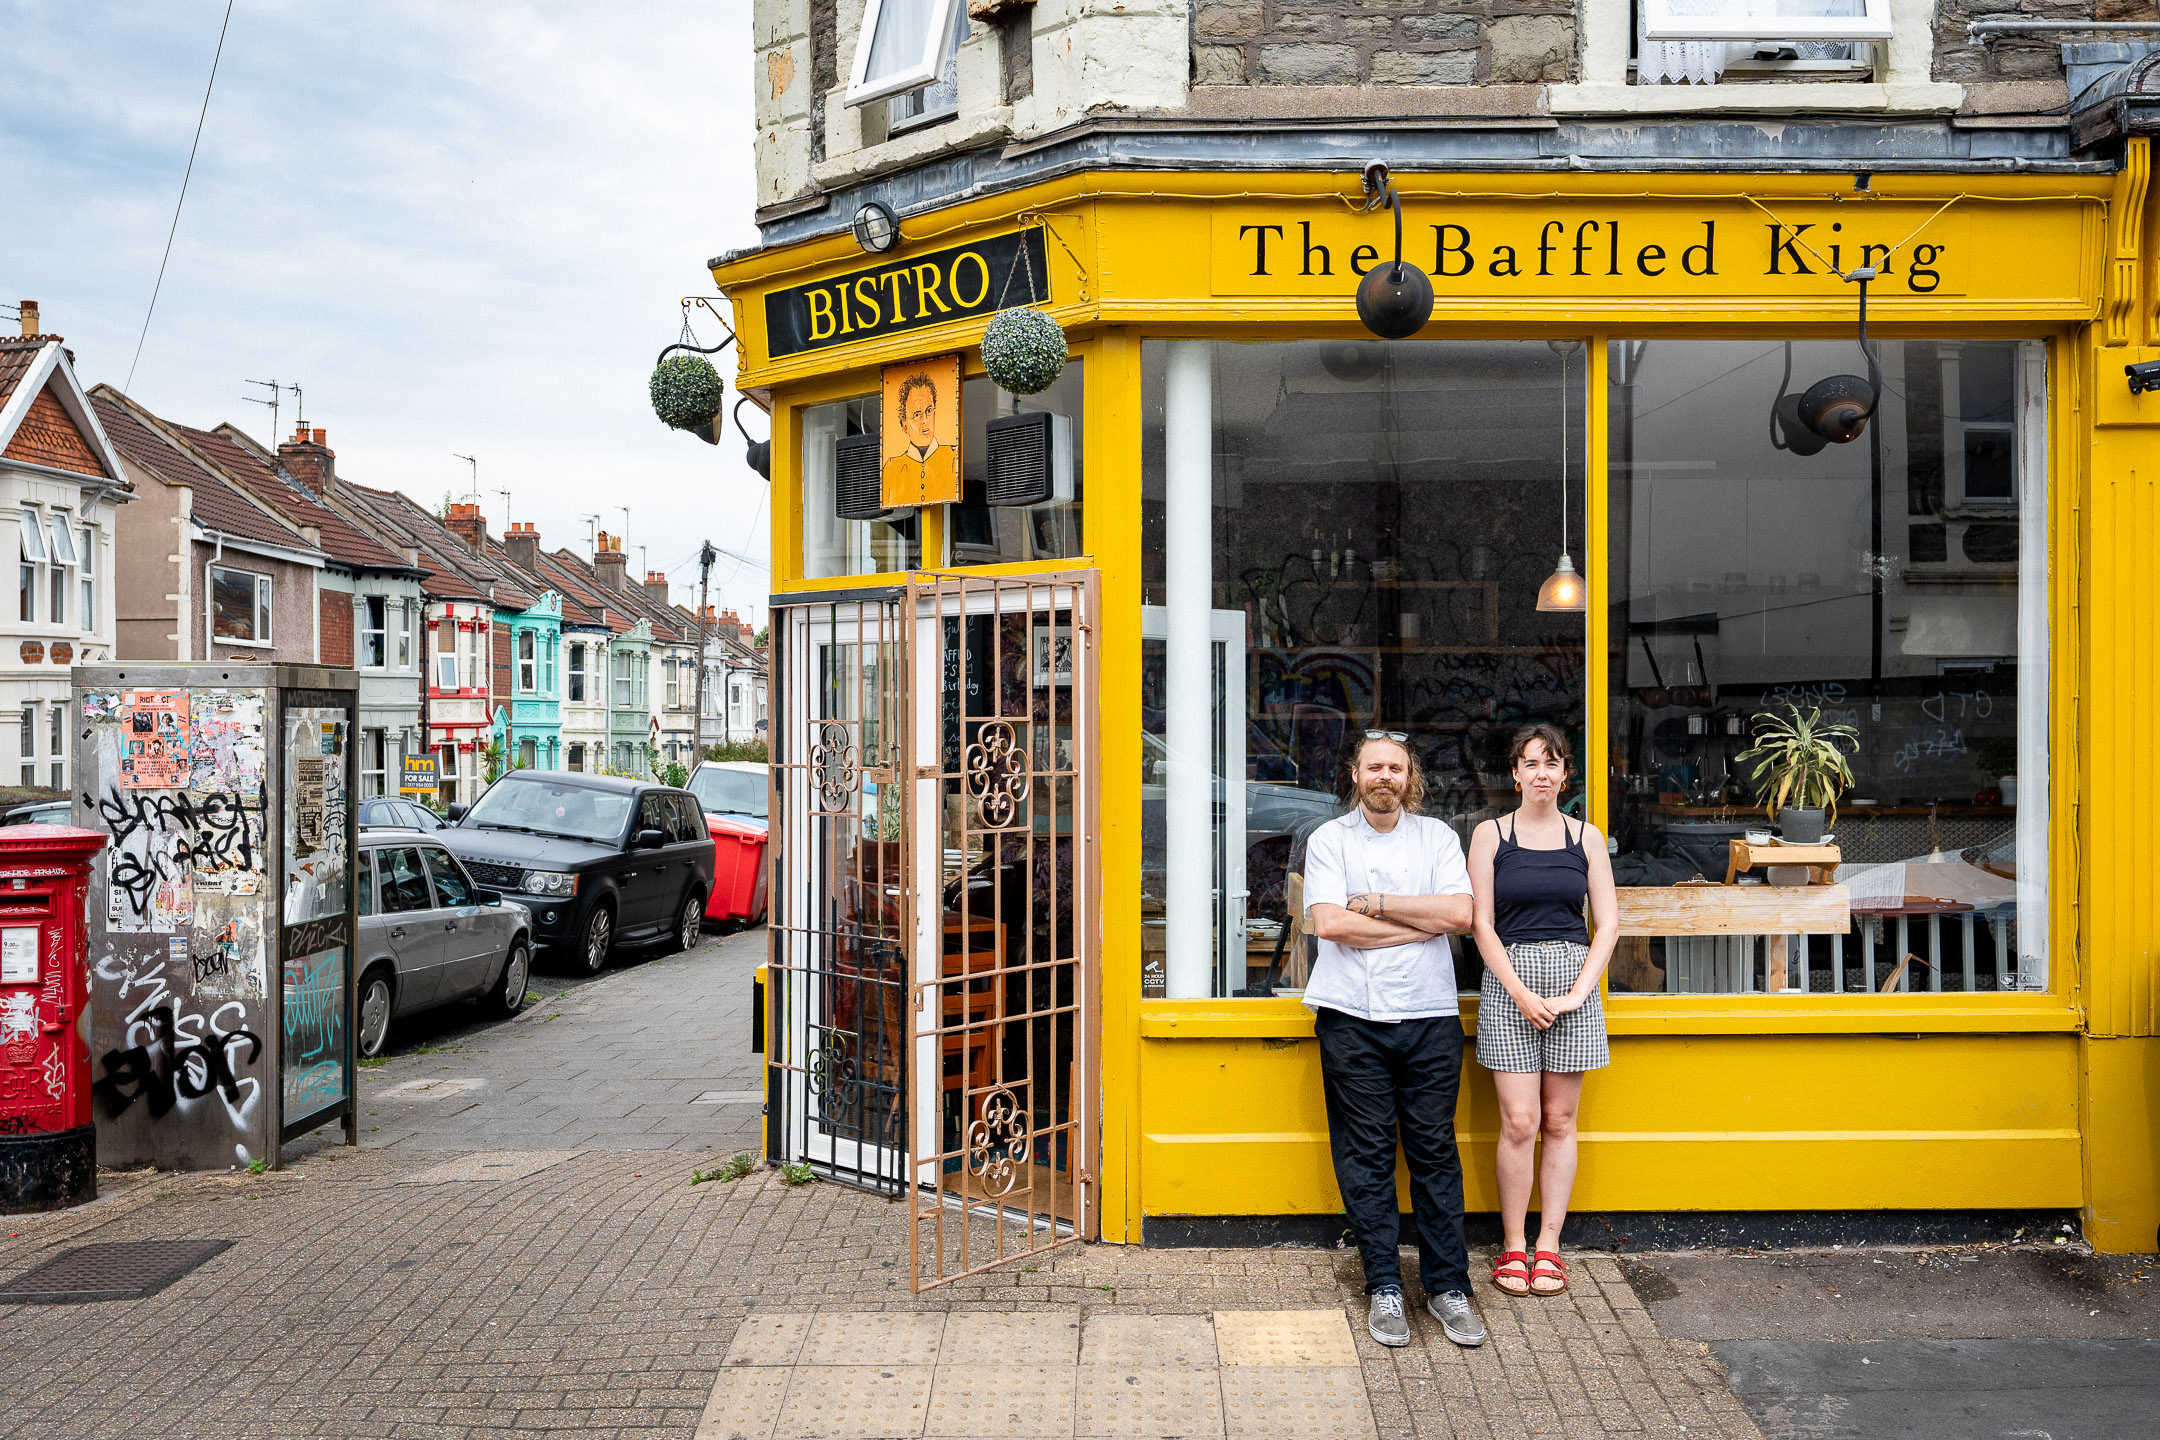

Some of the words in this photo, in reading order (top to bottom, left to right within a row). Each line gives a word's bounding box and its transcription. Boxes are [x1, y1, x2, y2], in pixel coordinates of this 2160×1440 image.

[1238, 220, 1380, 277] The
[1429, 219, 1719, 278] Baffled
[1766, 221, 1947, 294] King
[804, 251, 991, 341] BISTRO
[943, 678, 979, 696] Birtday
[405, 755, 434, 771] hm
[480, 857, 521, 867] ROVER
[21, 1102, 62, 1117] OFFICE
